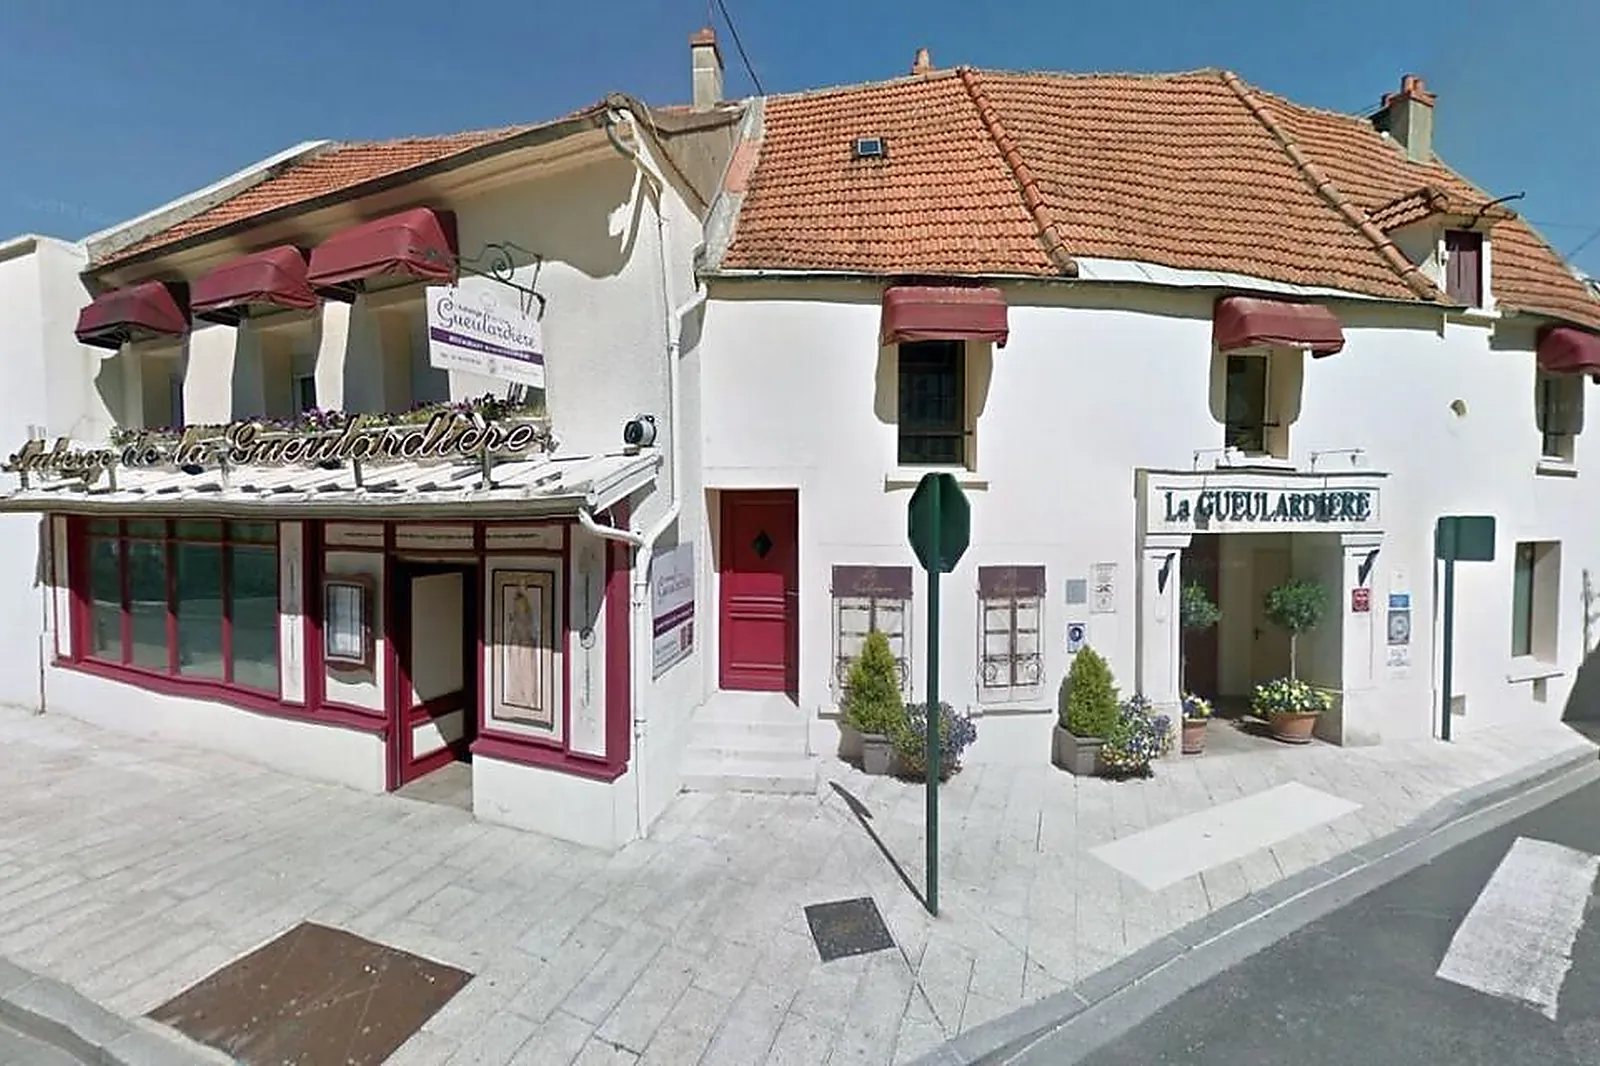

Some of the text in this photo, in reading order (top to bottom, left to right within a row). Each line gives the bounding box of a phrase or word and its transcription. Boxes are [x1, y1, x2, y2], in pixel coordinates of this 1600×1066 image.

[173, 426, 211, 466] la
[1165, 491, 1371, 522] La GUEULARDIERE
